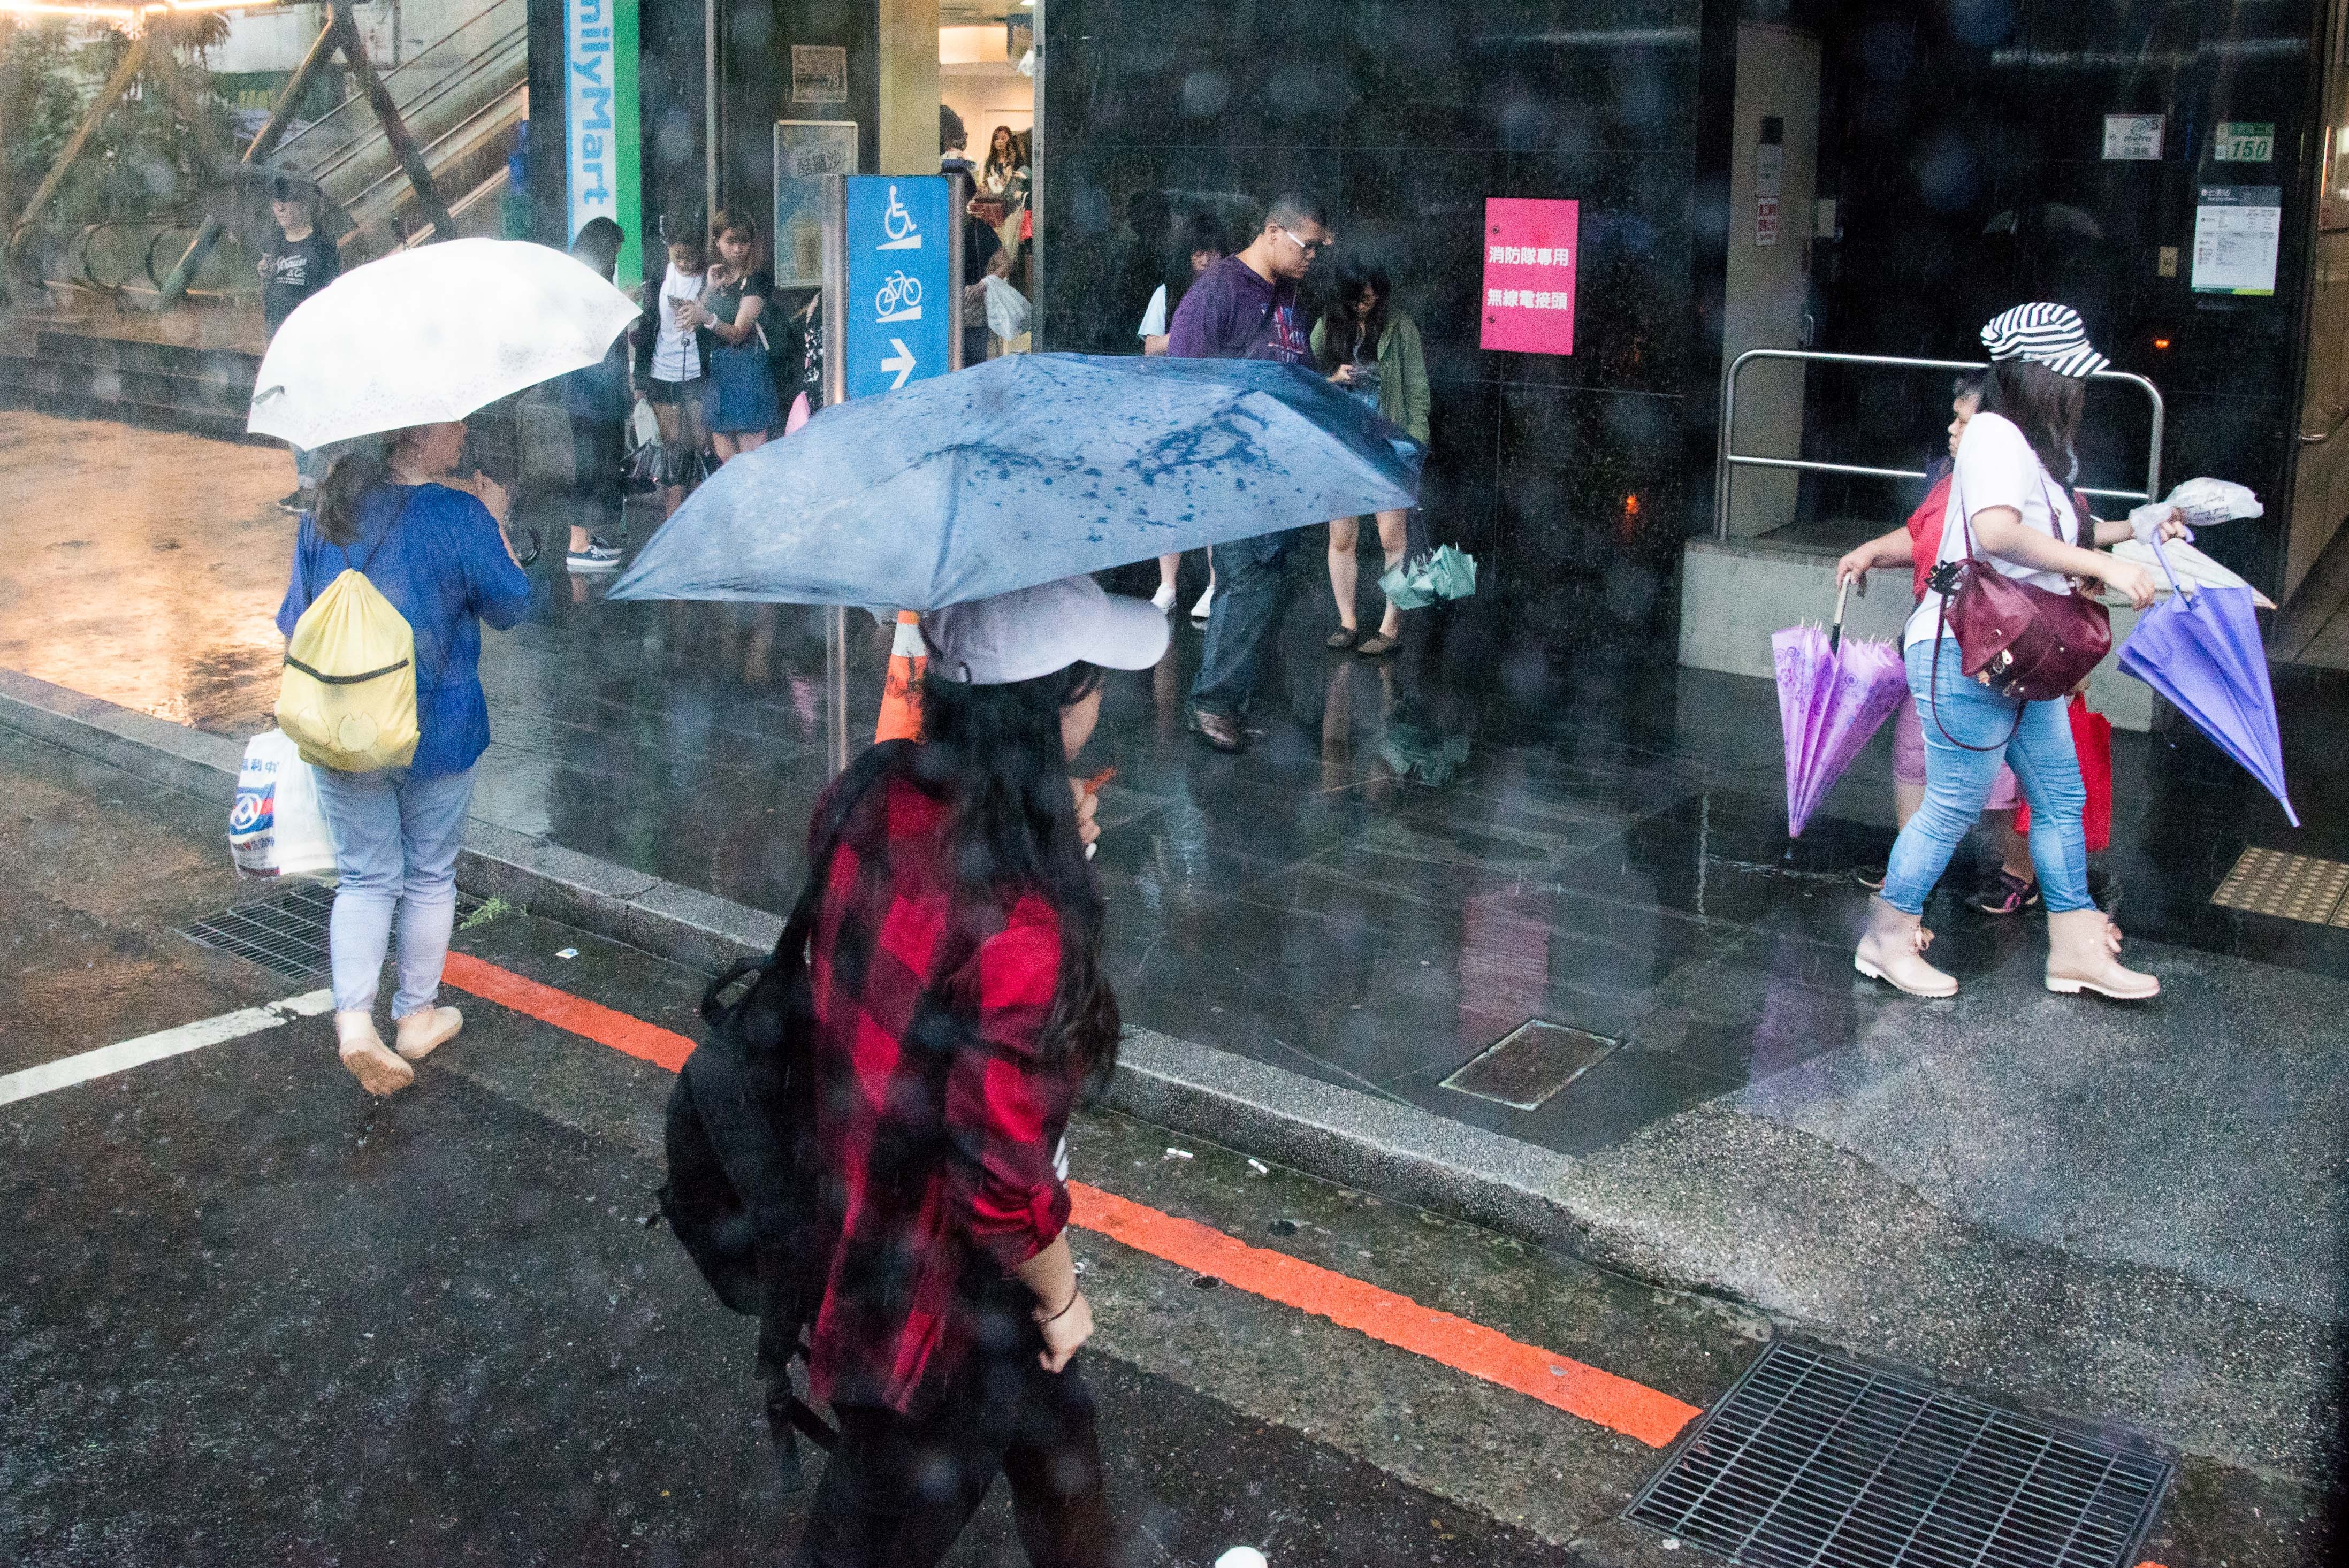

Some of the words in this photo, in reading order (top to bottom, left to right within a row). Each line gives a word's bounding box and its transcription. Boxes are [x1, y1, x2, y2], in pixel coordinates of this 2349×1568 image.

[2233, 140, 2268, 158] 150
[1489, 246, 1569, 266] 消防隊專用
[1488, 289, 1567, 310] 無線電接頭
